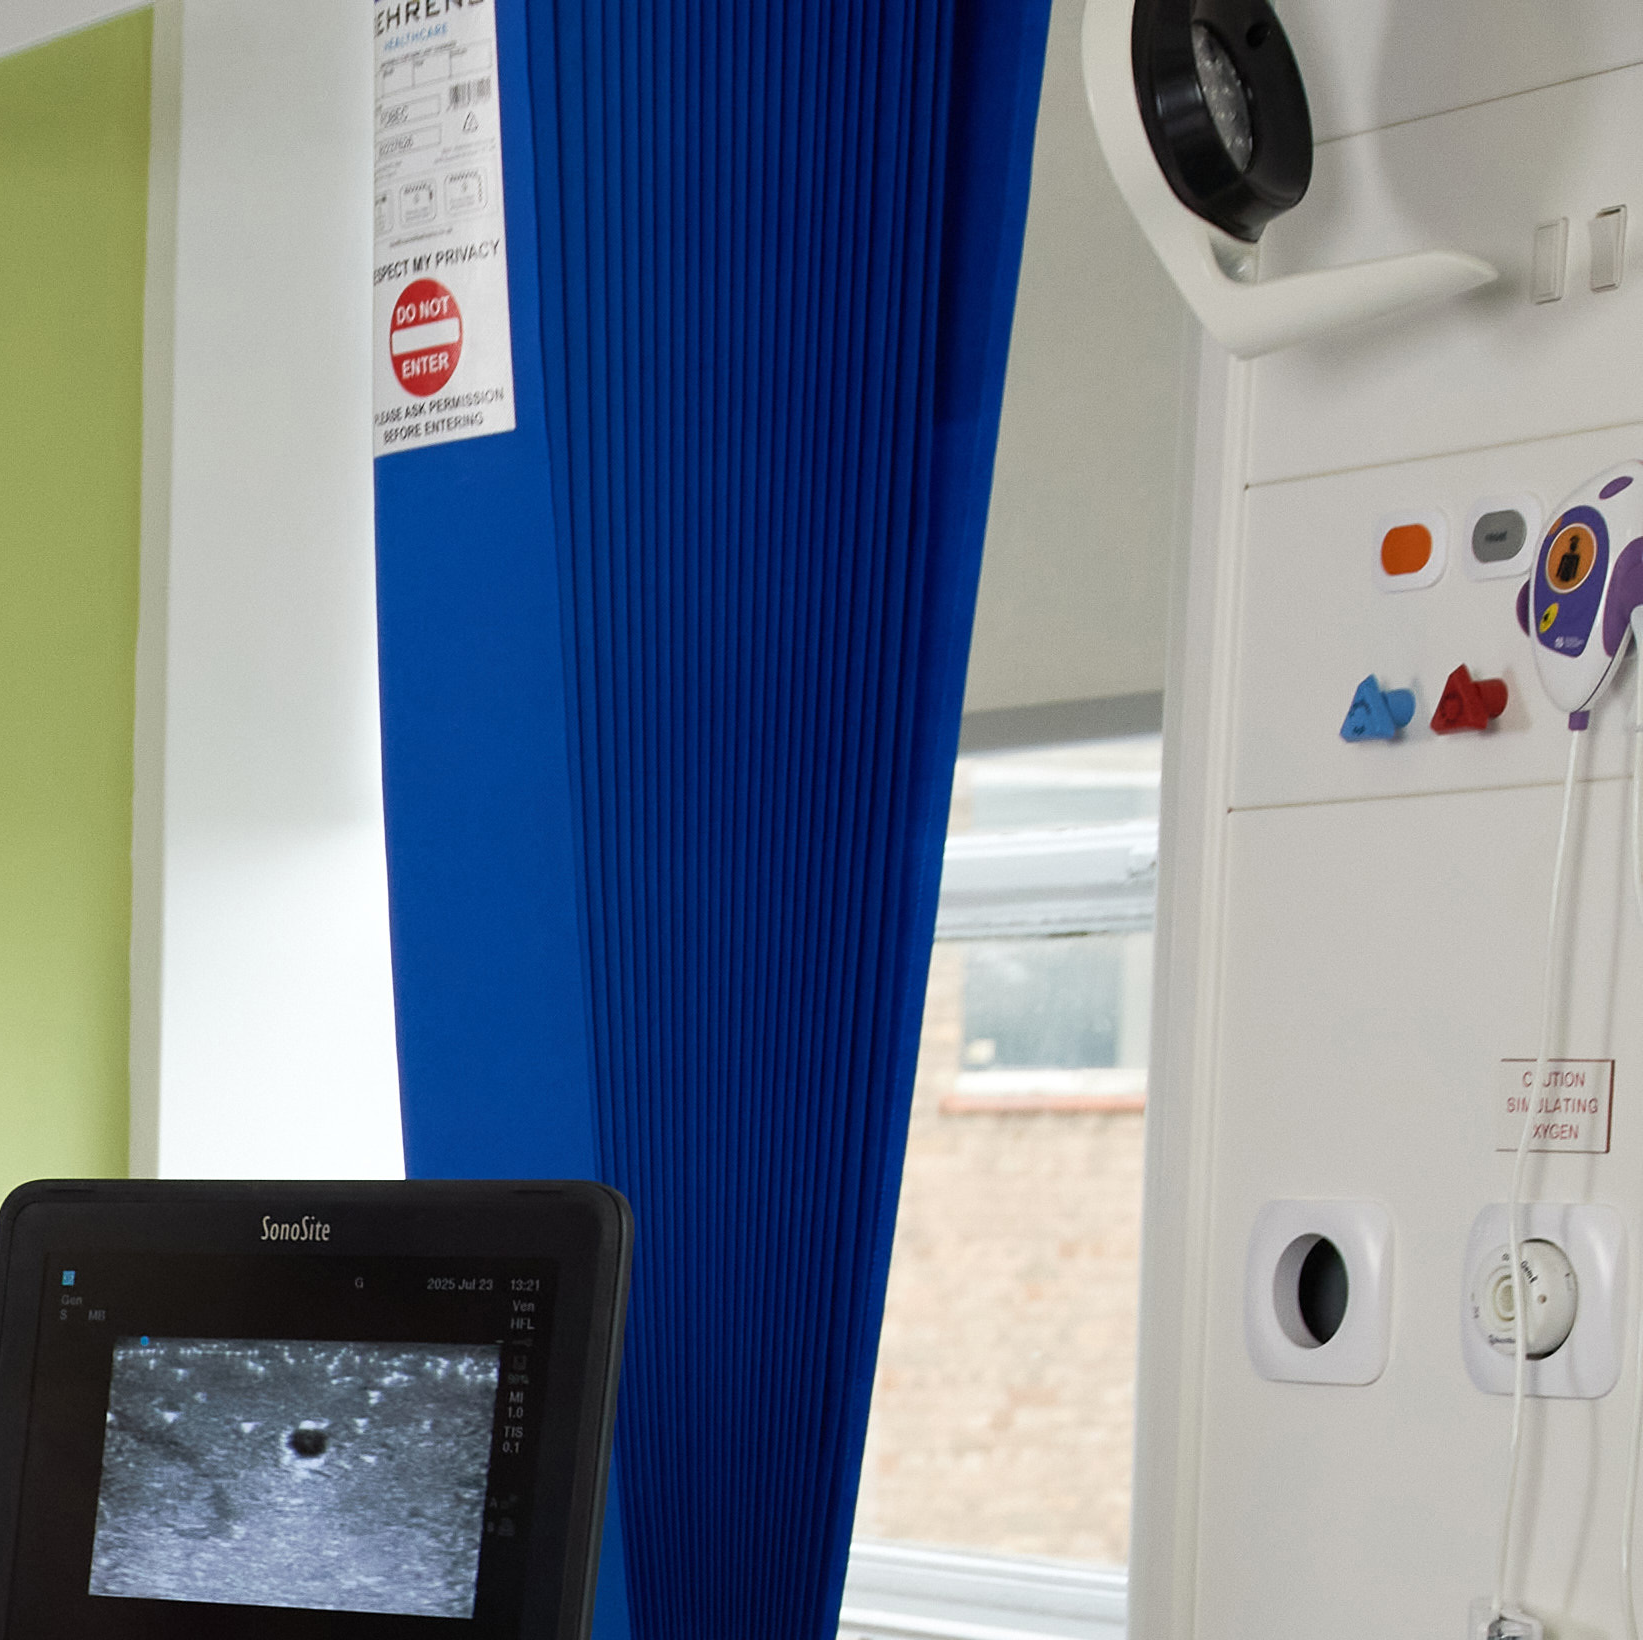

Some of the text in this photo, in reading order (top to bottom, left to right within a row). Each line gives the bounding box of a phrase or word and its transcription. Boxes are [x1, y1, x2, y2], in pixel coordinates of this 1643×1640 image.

[413, 253, 432, 272] MY
[435, 238, 500, 269] PRIVACY
[396, 295, 451, 326] DO NOT
[401, 351, 450, 380] ENTER
[404, 401, 427, 420] ASK
[429, 387, 505, 414] PERMISSION
[383, 411, 484, 445] BEFORE ENTERING
[1522, 1071, 1586, 1088] CUTION
[1532, 1124, 1580, 1140] XYGEN
[260, 1215, 331, 1241] SonoSite
[427, 1278, 494, 1291] 2025 Jul 23
[510, 1279, 540, 1292] 13:21
[510, 1317, 535, 1330] HFL
[509, 1391, 524, 1404] MI
[508, 1406, 524, 1419] 1.0
[504, 1425, 524, 1438] TIS
[502, 1441, 520, 1454] 0.1
